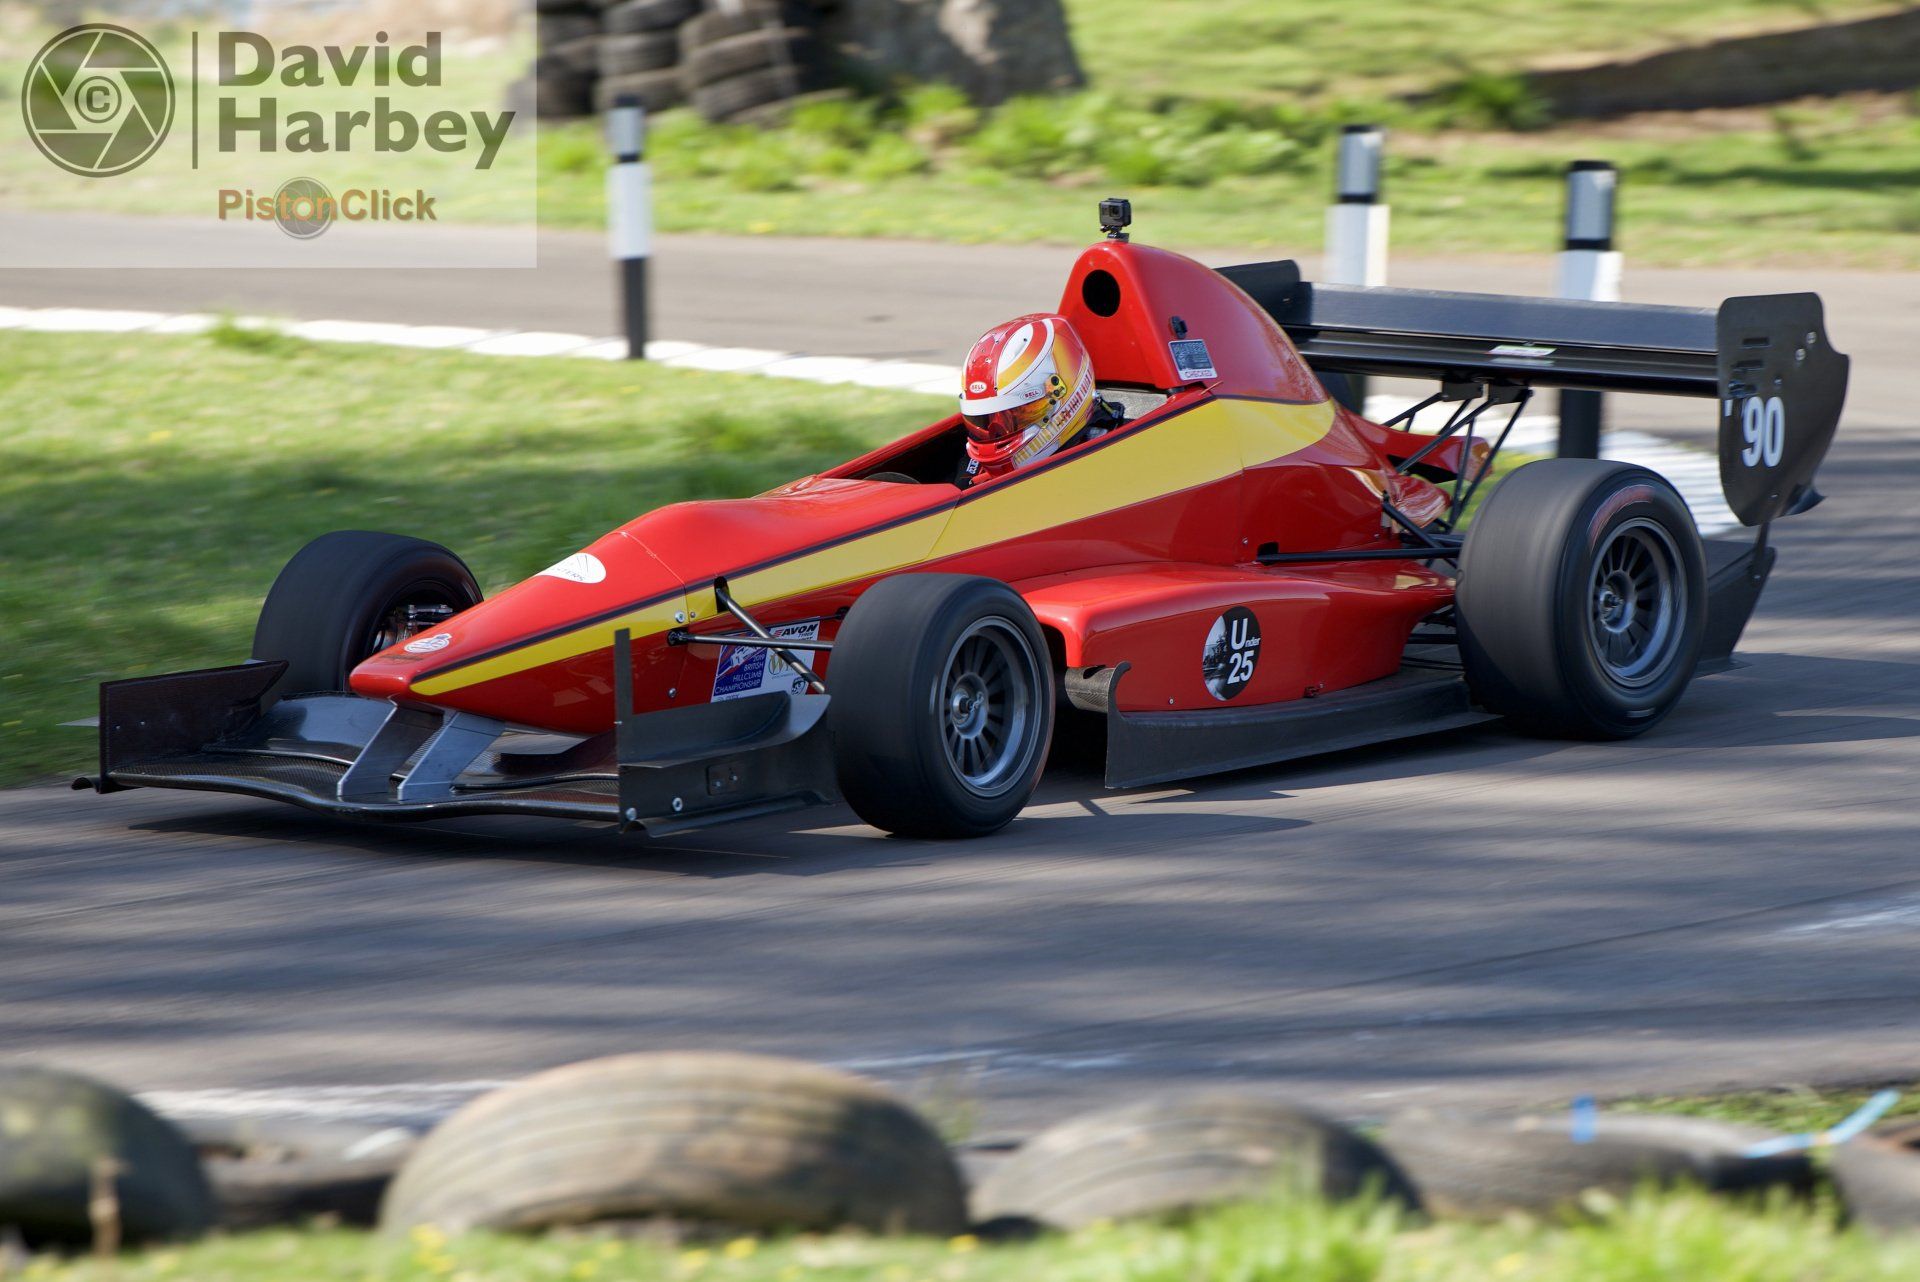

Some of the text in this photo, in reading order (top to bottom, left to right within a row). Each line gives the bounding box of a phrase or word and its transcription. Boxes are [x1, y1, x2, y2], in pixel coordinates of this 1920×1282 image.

[1024, 390, 1039, 399] BELL
[782, 623, 819, 637] AVON
[744, 662, 764, 672] BRITISH
[1227, 649, 1255, 685] 25
[733, 671, 762, 683] HILLCLIMB
[715, 679, 760, 694] CHAMPIONSHIP
